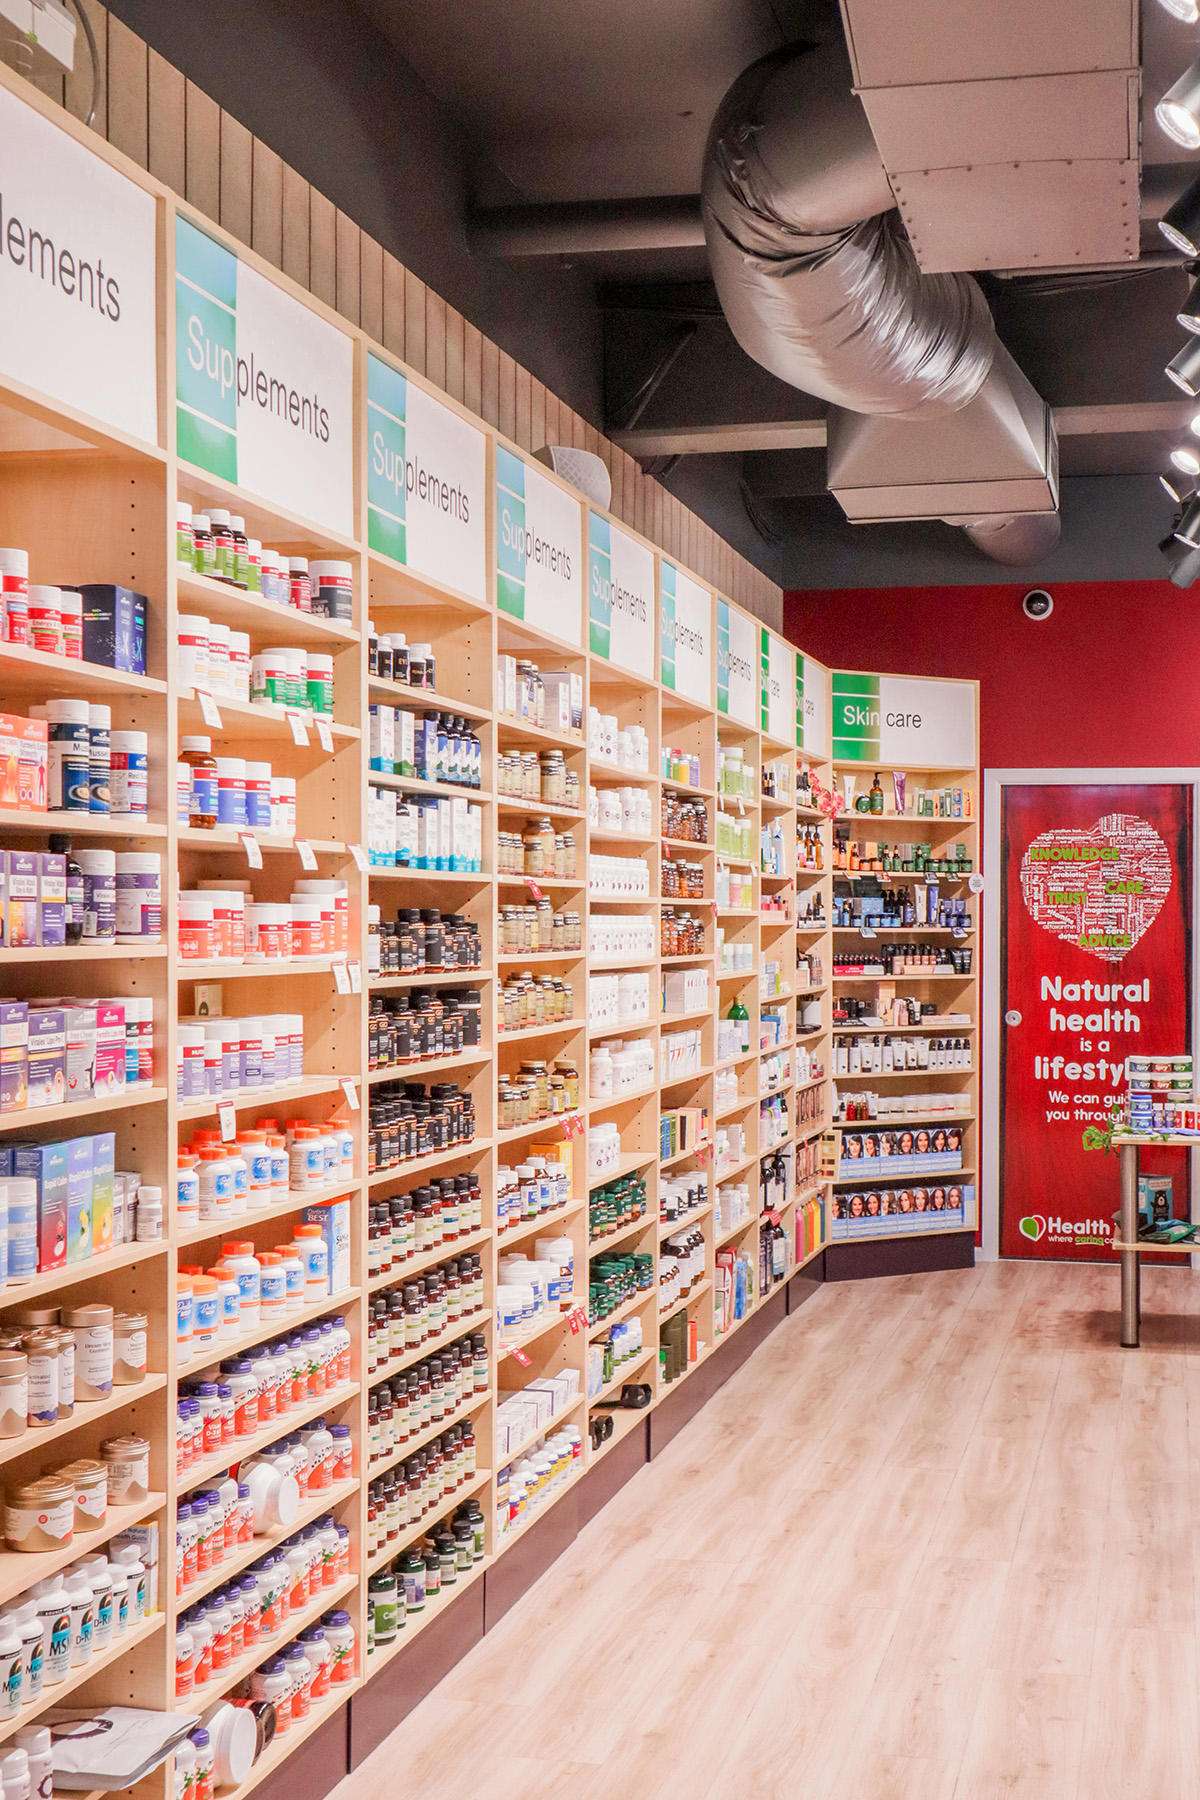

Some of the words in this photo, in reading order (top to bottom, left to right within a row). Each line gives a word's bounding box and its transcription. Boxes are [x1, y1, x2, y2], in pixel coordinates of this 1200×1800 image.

[187, 314, 330, 443] Supplements
[372, 431, 469, 524] Supplements
[502, 508, 571, 581] Supplements
[592, 565, 647, 623] Supplements
[661, 604, 704, 655] Supplements
[718, 640, 751, 681] Supplements
[771, 679, 780, 698] care
[805, 699, 814, 717] care
[843, 705, 880, 727] Skin
[886, 711, 922, 729] care
[1031, 847, 1120, 861] KNOWLEDGE
[1105, 881, 1144, 895] CARE
[1150, 886, 1170, 894] sleep
[1047, 892, 1088, 905] TRUST
[12, 927, 18, 937] 2
[1088, 926, 1104, 934] skin
[1079, 934, 1131, 948] ADVICE
[1041, 975, 1150, 1003] Natural
[1050, 1007, 1140, 1033] health
[1080, 1037, 1092, 1052] is
[1098, 1040, 1110, 1052] a
[1034, 1056, 1130, 1087] lifestyl
[1048, 1090, 1070, 1104] We
[1073, 1093, 1100, 1104] can
[1103, 1092, 1130, 1108] gui
[1046, 1112, 1070, 1123] you
[308, 1214, 328, 1222] BEST
[1047, 1216, 1111, 1236] Health
[1047, 1235, 1073, 1243] where
[1075, 1236, 1104, 1246] caring
[49, 1637, 71, 1656] MS
